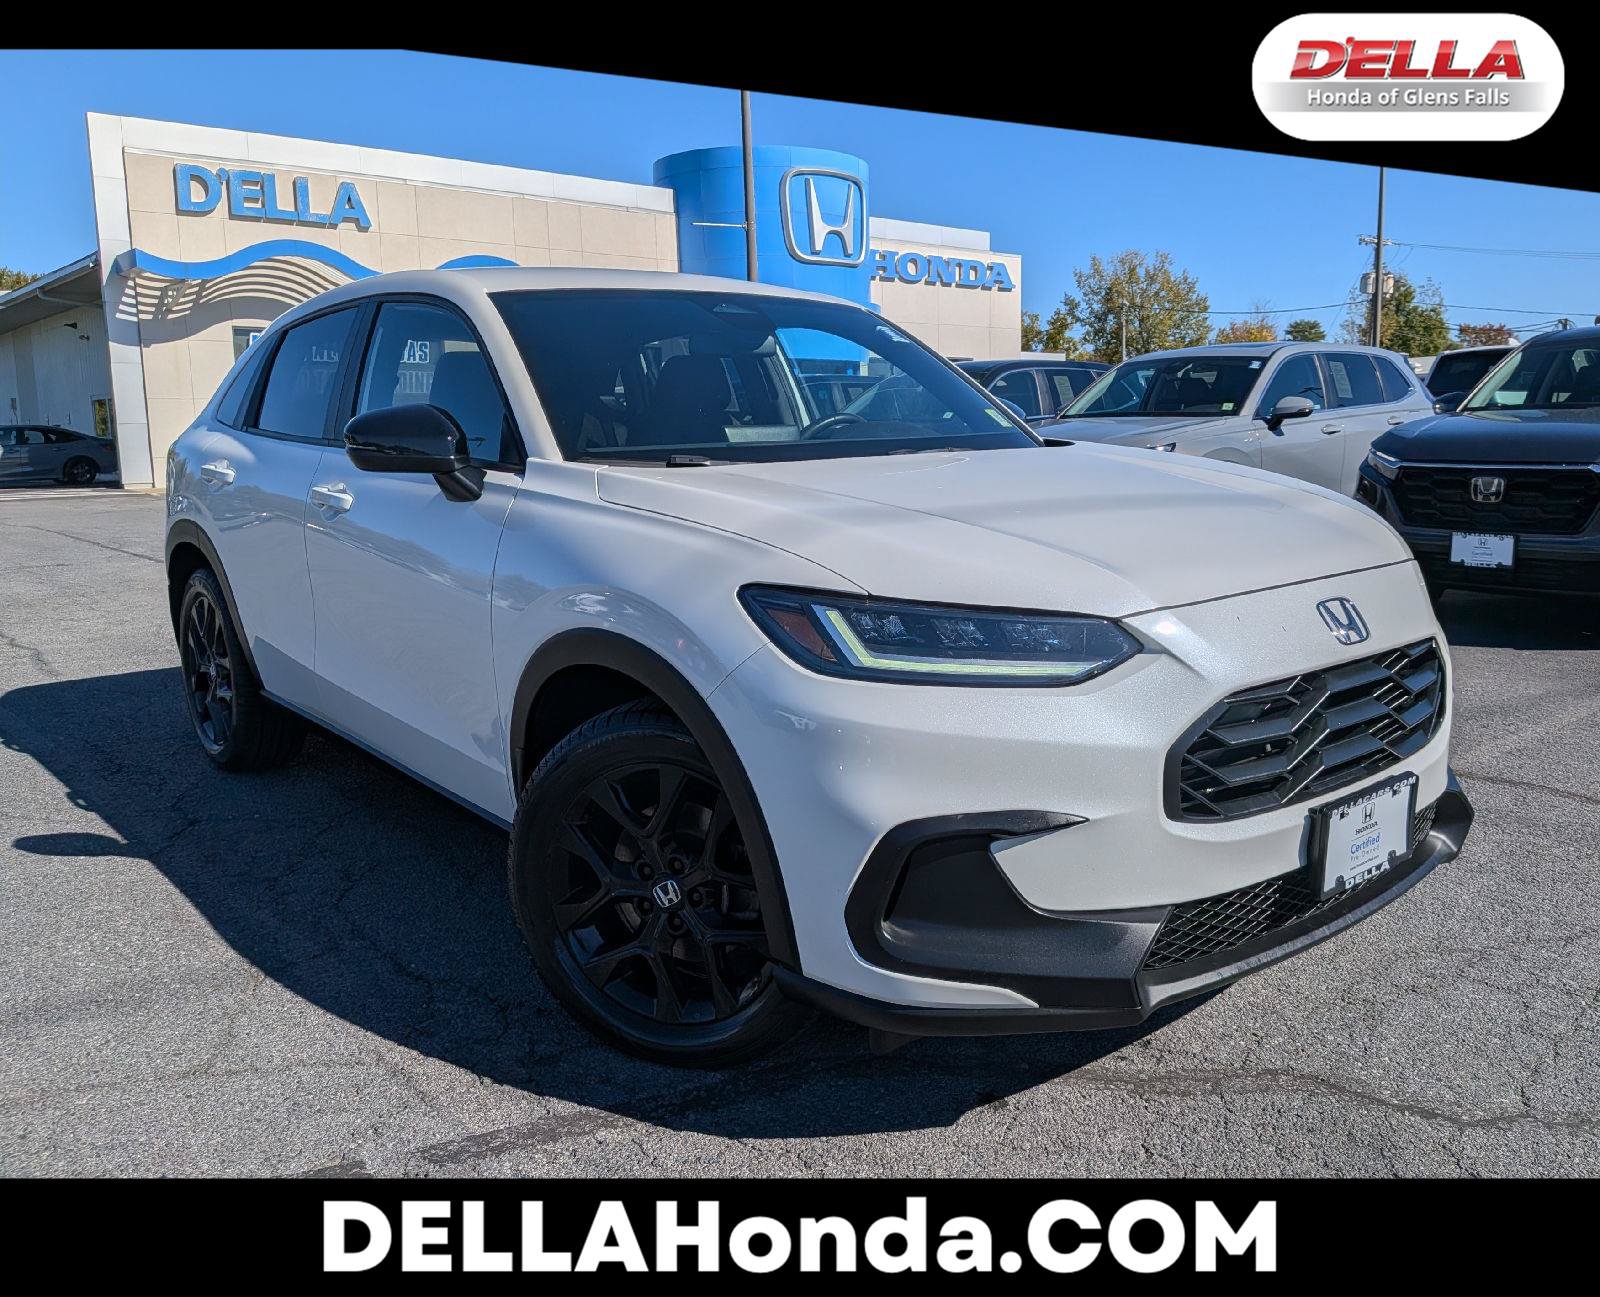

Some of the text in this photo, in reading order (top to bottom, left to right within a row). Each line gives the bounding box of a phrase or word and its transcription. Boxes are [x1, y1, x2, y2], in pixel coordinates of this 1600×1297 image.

[173, 163, 372, 232] D'ELLA
[869, 248, 1016, 292] HONDA
[1350, 833, 1381, 855] Certified
[1345, 861, 1391, 887] DELLA
